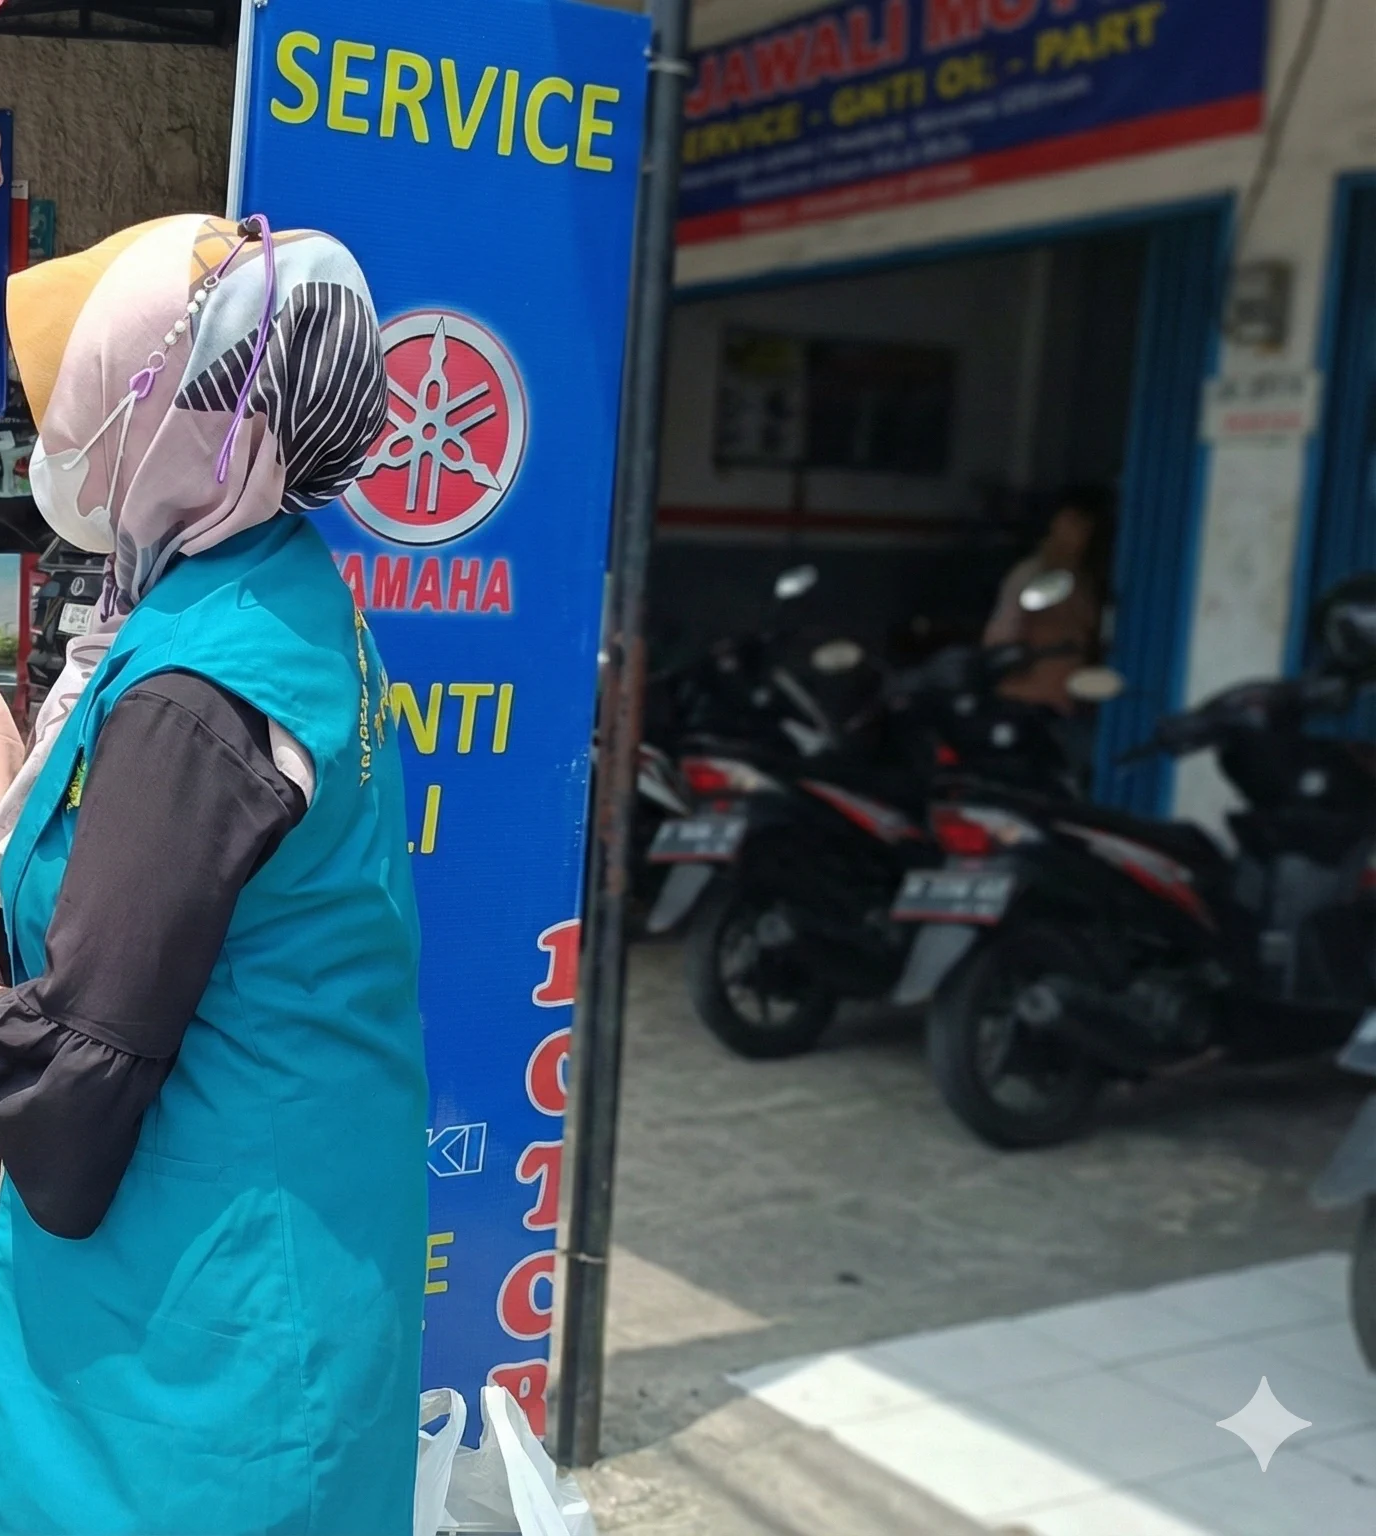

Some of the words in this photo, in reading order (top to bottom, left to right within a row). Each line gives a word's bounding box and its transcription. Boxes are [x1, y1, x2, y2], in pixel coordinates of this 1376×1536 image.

[1036, 4, 1164, 73] PART
[270, 31, 620, 173] SERVICE
[332, 551, 513, 614] AMAHA
